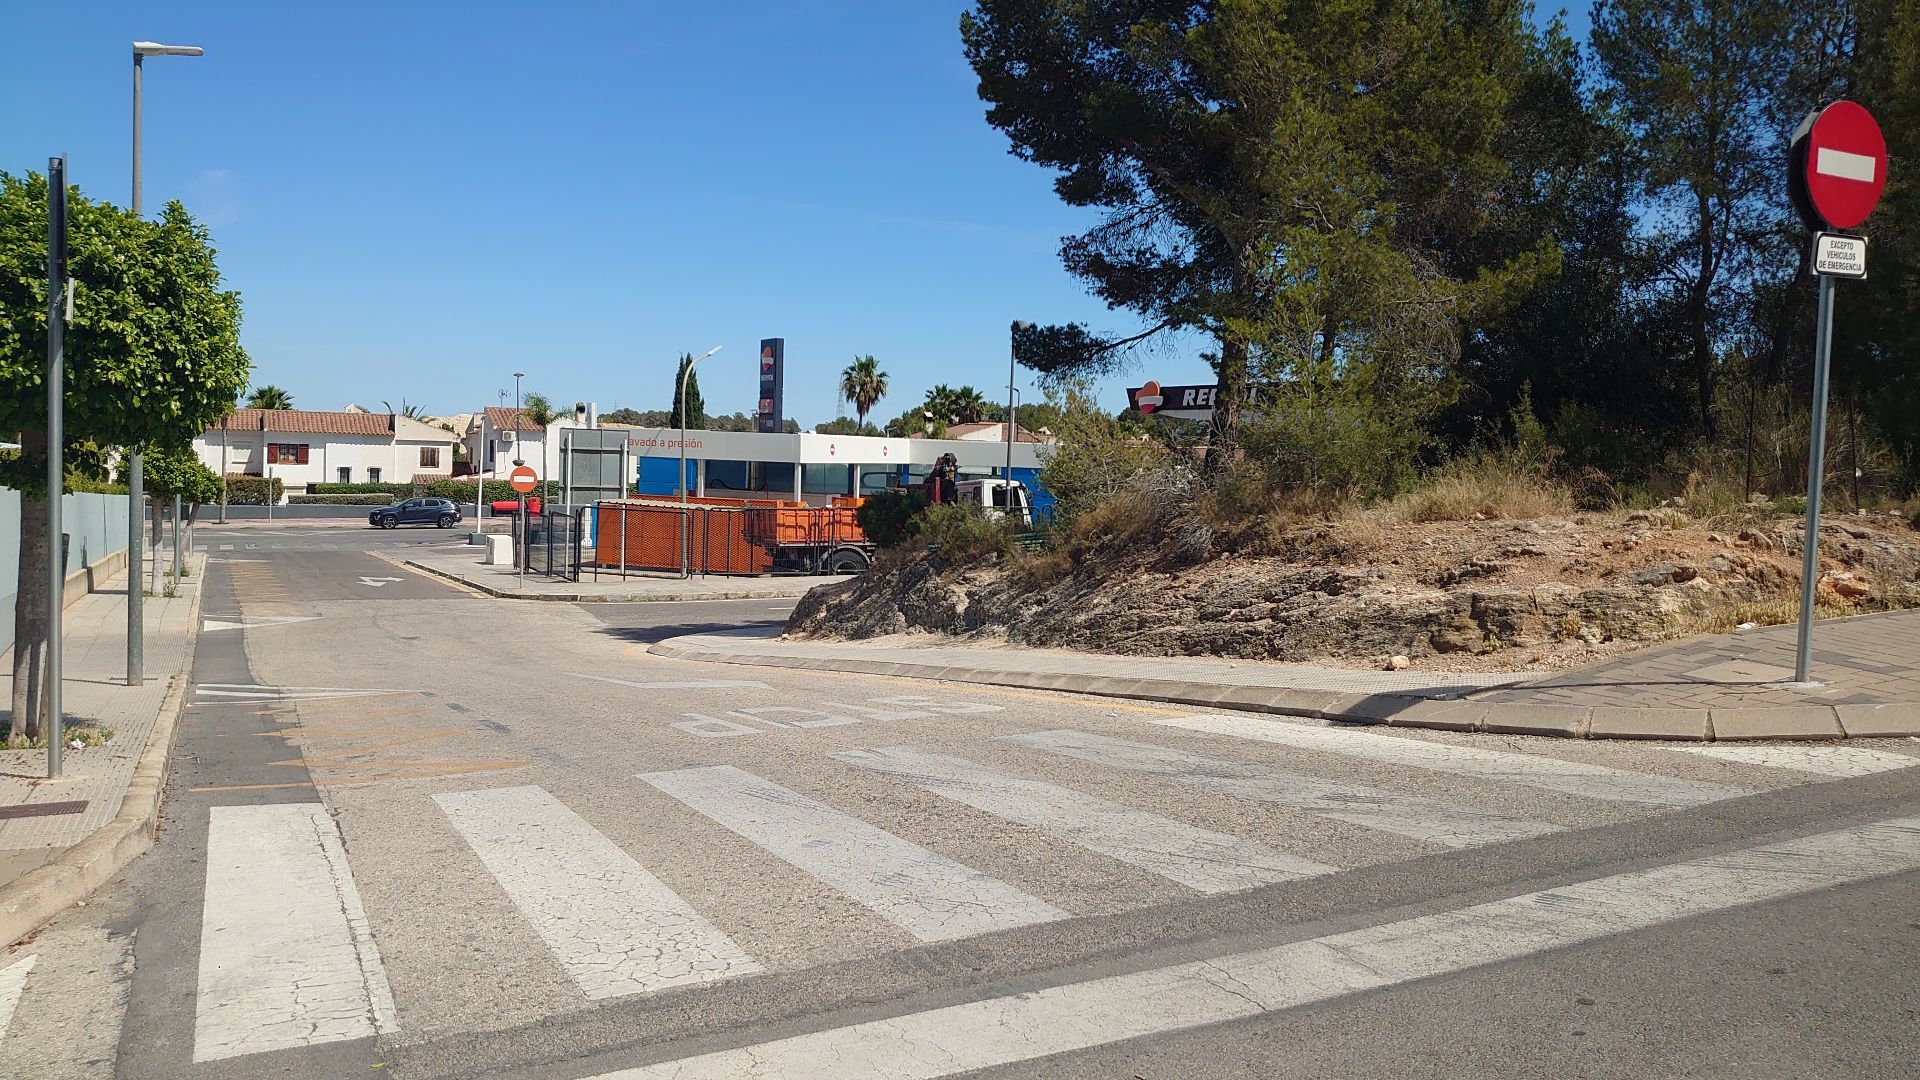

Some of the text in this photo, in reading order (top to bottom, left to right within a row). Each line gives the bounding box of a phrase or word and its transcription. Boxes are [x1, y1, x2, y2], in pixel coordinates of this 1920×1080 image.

[1830, 240, 1853, 250] EXCEPTO
[1819, 260, 1861, 271] DE EMERGENCIA
[629, 437, 703, 449] avado a presión
[669, 695, 1006, 738] STOP
